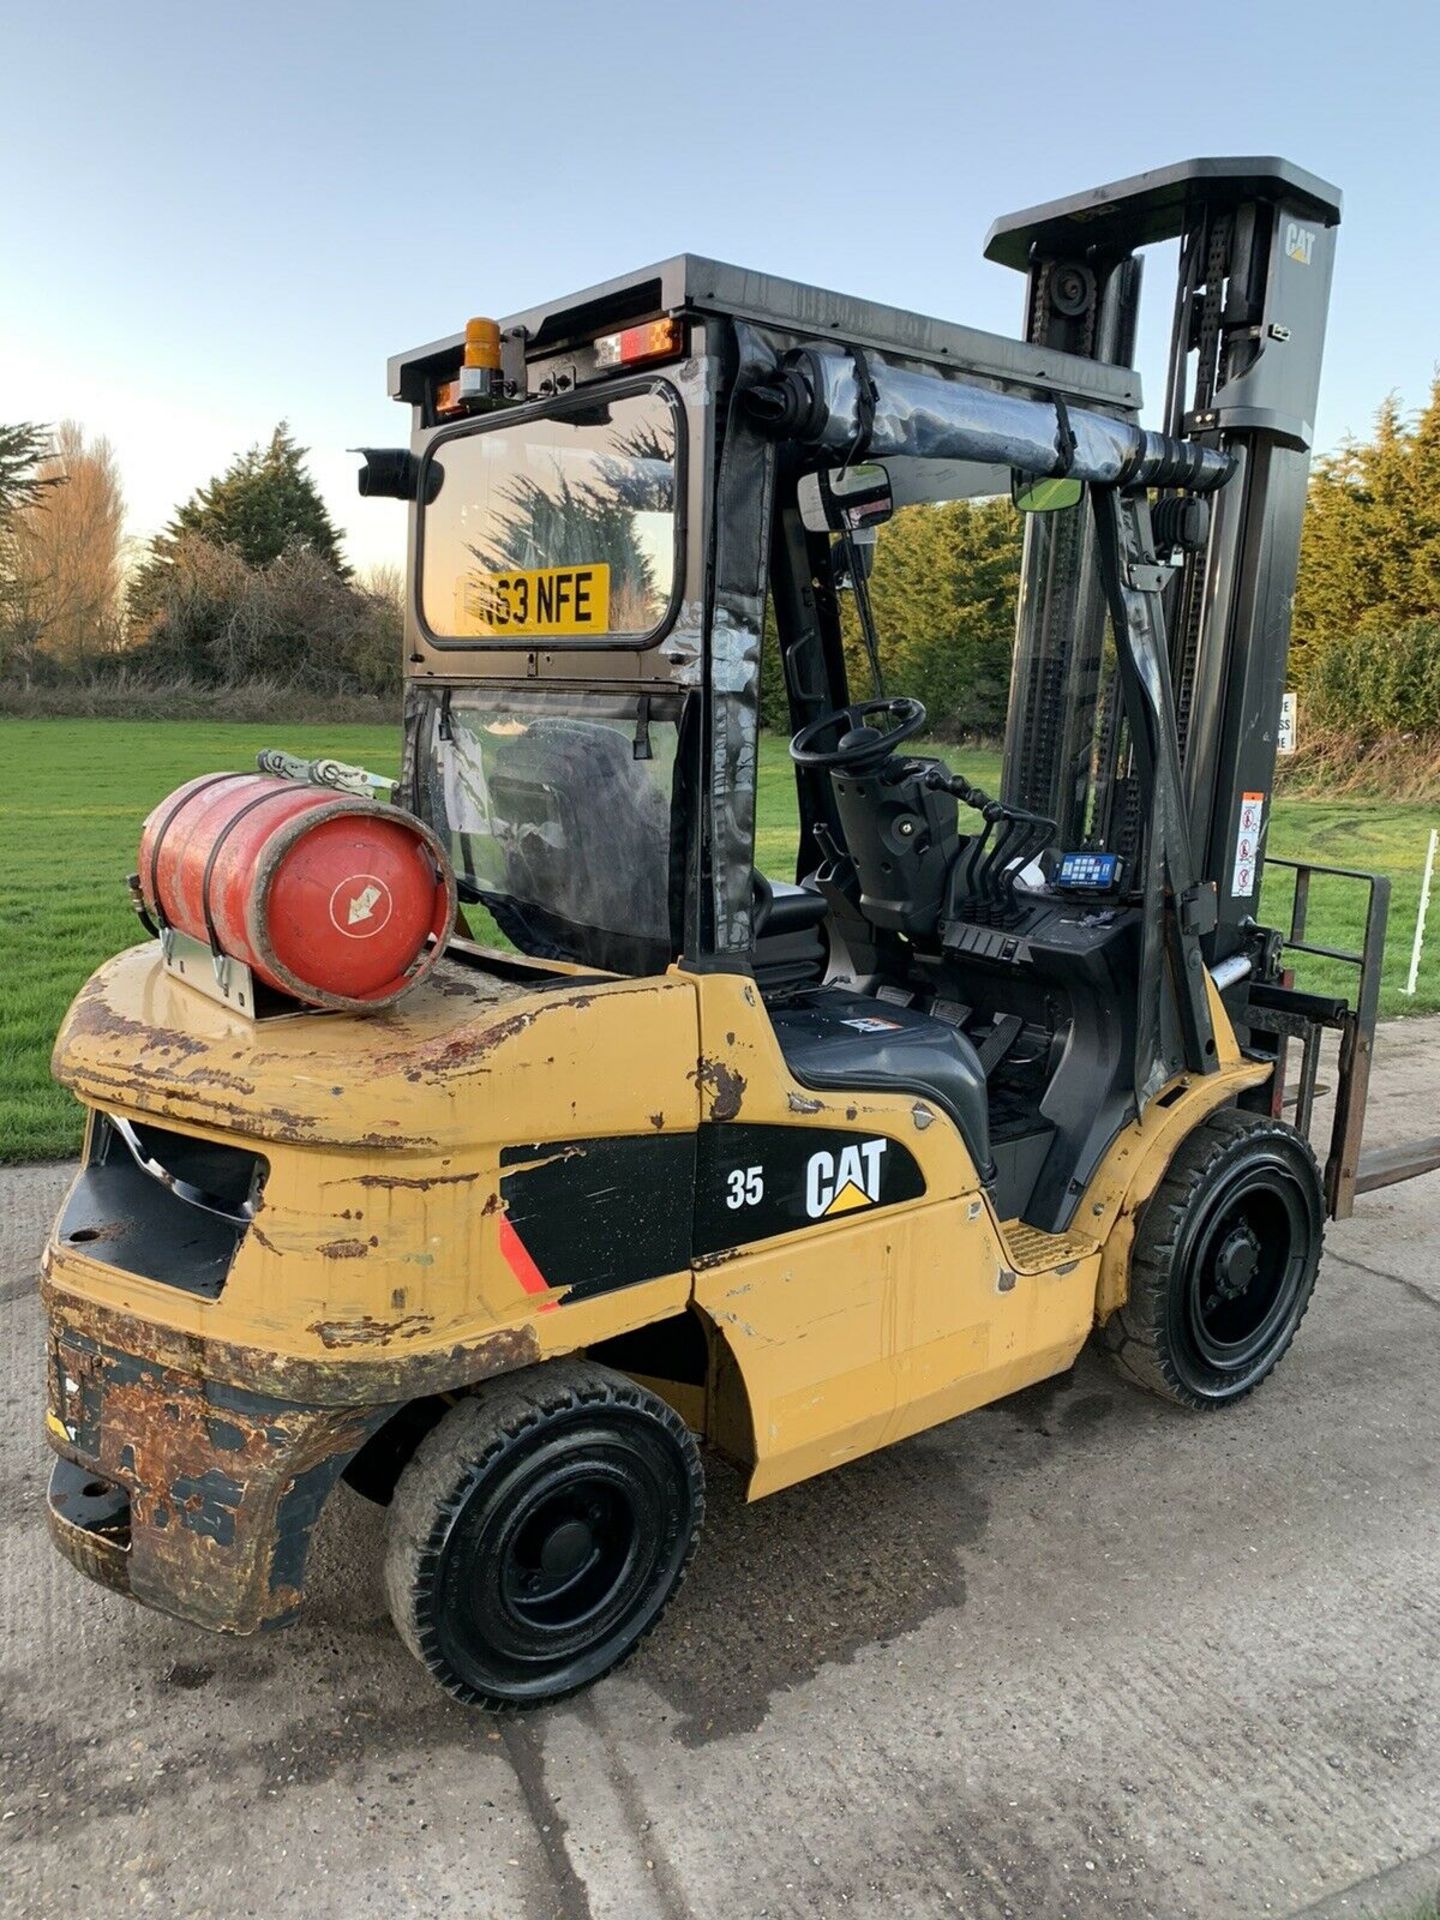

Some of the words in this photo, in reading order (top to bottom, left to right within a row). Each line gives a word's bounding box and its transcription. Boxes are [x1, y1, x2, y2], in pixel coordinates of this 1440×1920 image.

[1285, 223, 1316, 265] CAT
[537, 572, 593, 624] NFE
[726, 1165, 764, 1210] 35
[806, 1138, 887, 1218] CAT
